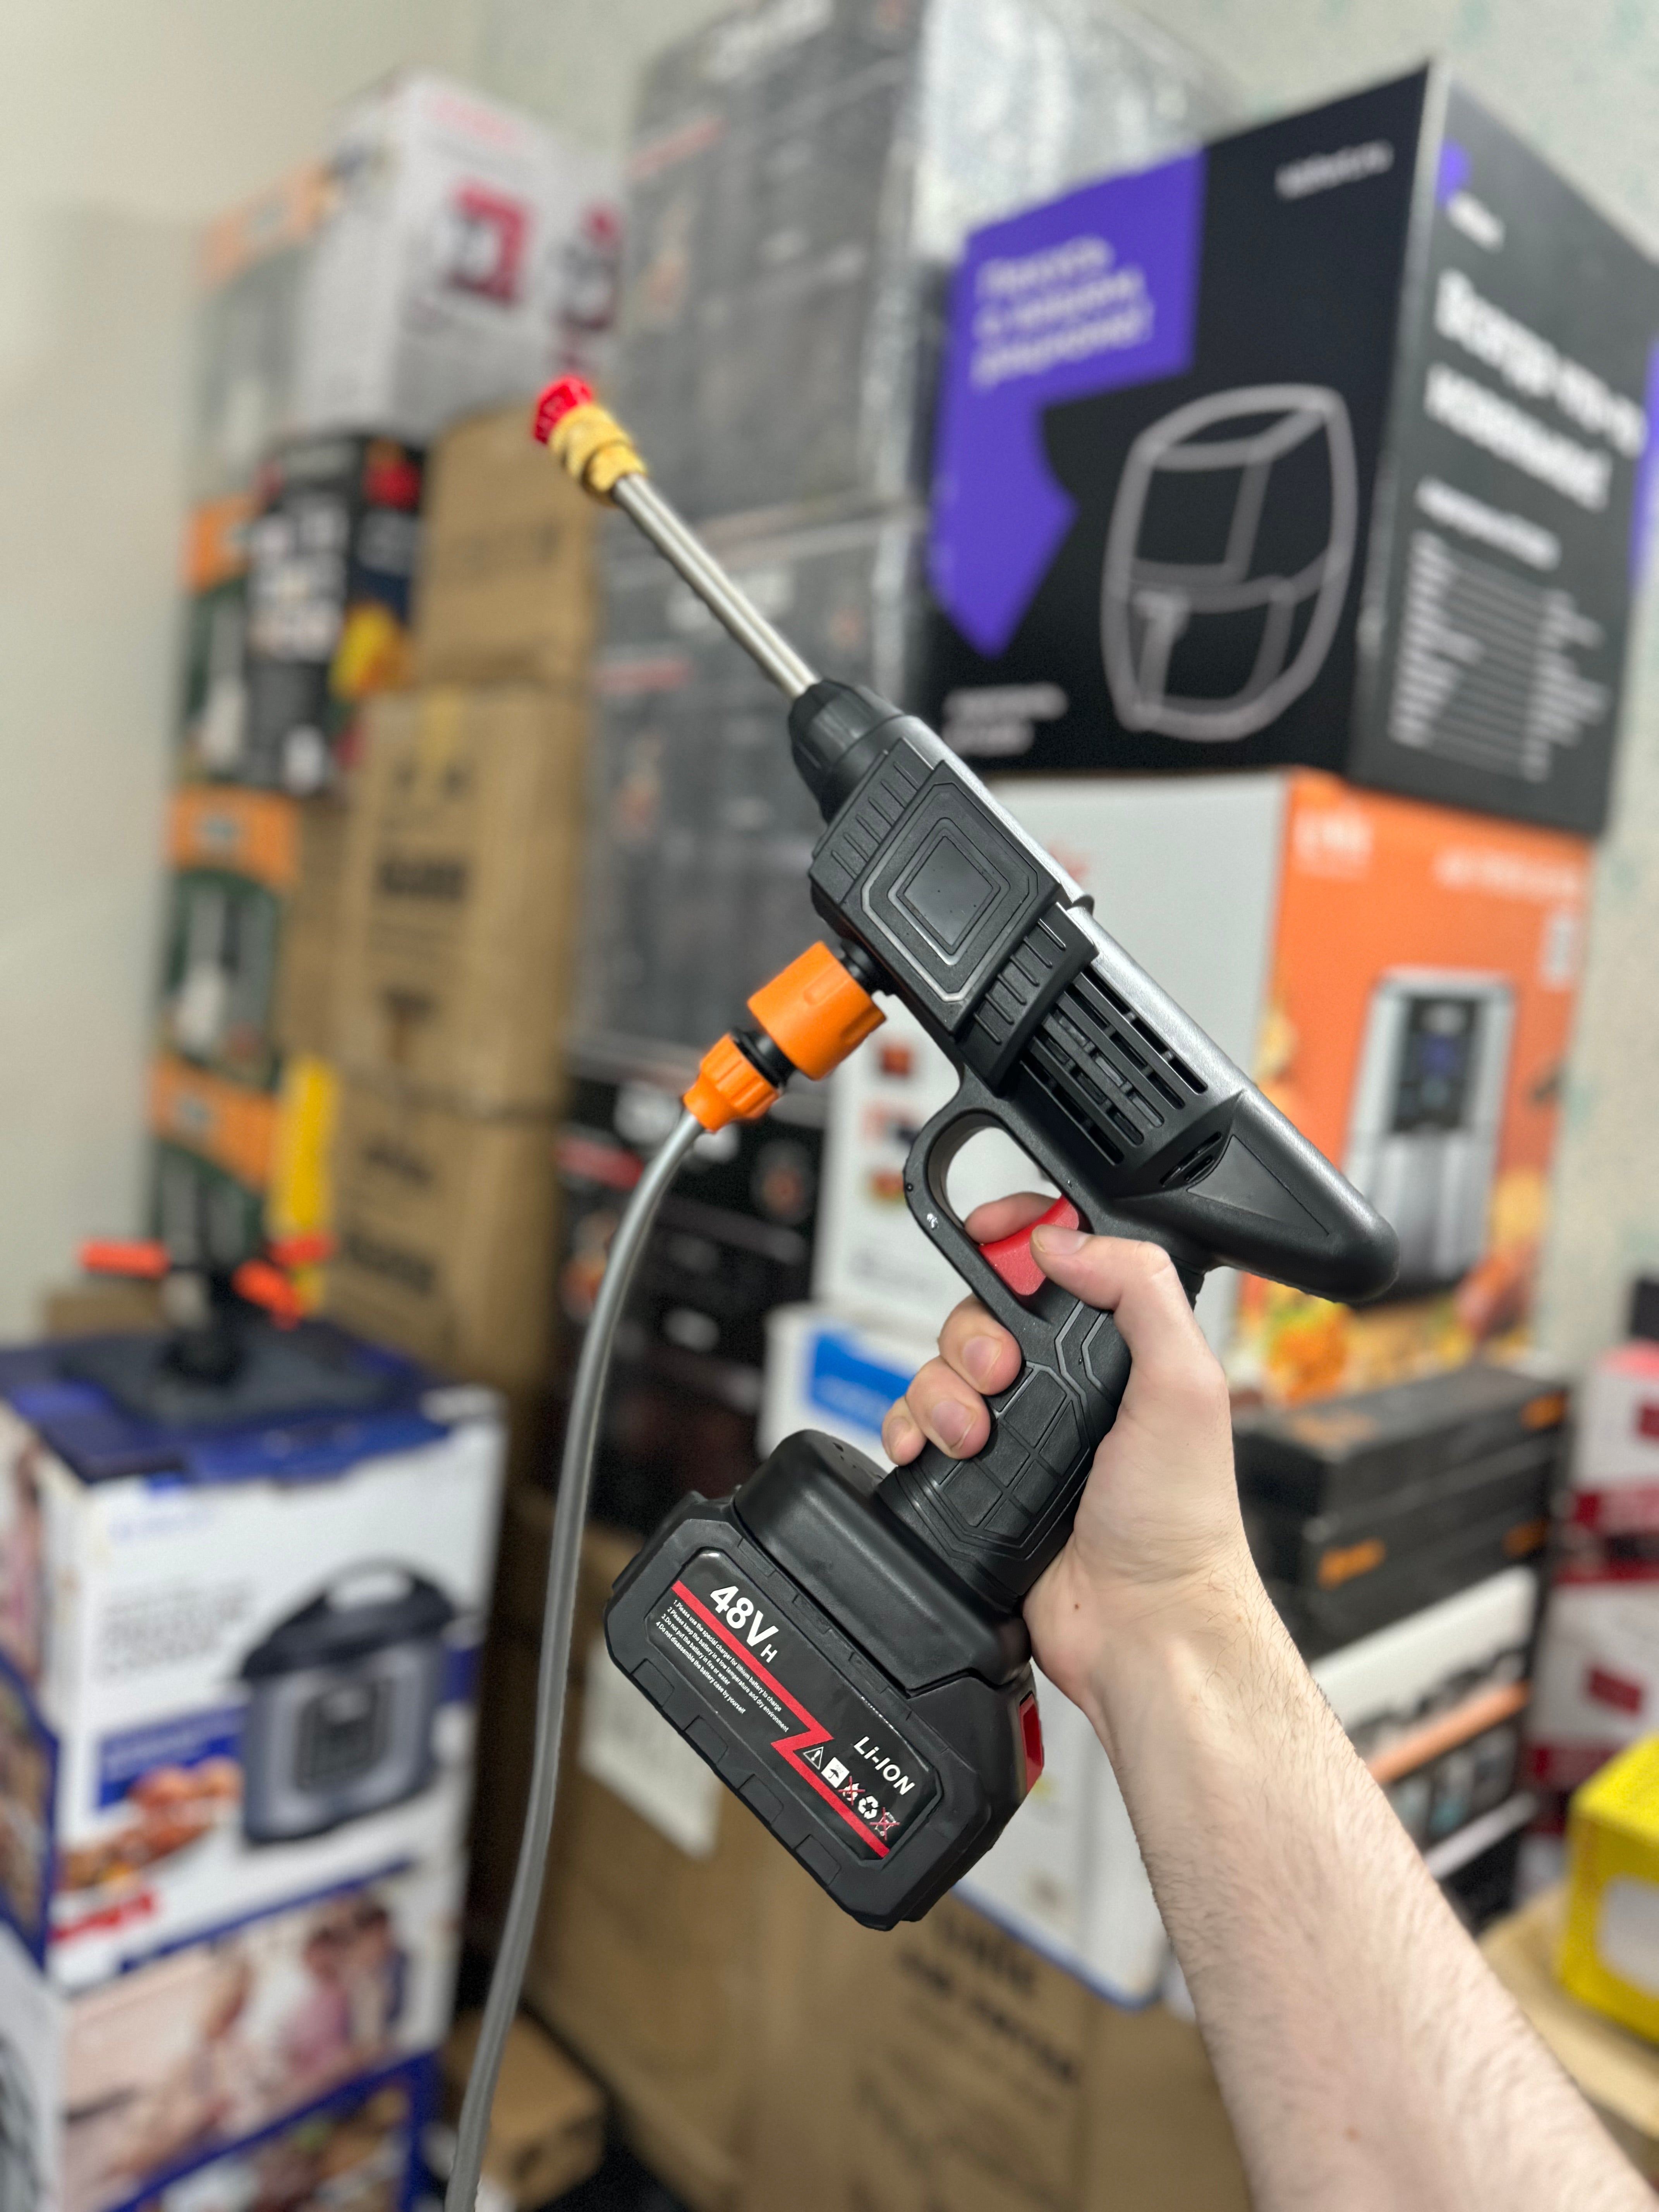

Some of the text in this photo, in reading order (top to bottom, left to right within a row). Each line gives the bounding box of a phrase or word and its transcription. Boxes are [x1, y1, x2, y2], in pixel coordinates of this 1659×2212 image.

[670, 1623, 678, 1632] not
[675, 1630, 685, 1639] put
[683, 1635, 691, 1645] the
[689, 1642, 704, 1659] battery
[718, 1672, 730, 1685] water
[710, 1586, 779, 1646] 48V
[658, 1623, 666, 1632] Do
[664, 1630, 673, 1639] not
[693, 1660, 701, 1669] the
[700, 1666, 715, 1683] battery
[713, 1681, 724, 1693] case
[722, 1690, 730, 1698] by
[726, 1696, 746, 1714] yourself
[670, 1609, 685, 1625] Please
[692, 1632, 700, 1641] the
[698, 1638, 714, 1656] battery
[719, 1659, 728, 1669] low
[748, 1691, 759, 1701] and
[756, 1699, 765, 1708] dry
[763, 1706, 789, 1733] environment
[689, 1616, 697, 1626] use
[702, 1630, 718, 1646] special
[716, 1644, 732, 1660] charger
[749, 1676, 764, 1694] battery
[767, 1696, 781, 1712] charge
[854, 1736, 915, 1795] Li-ION
